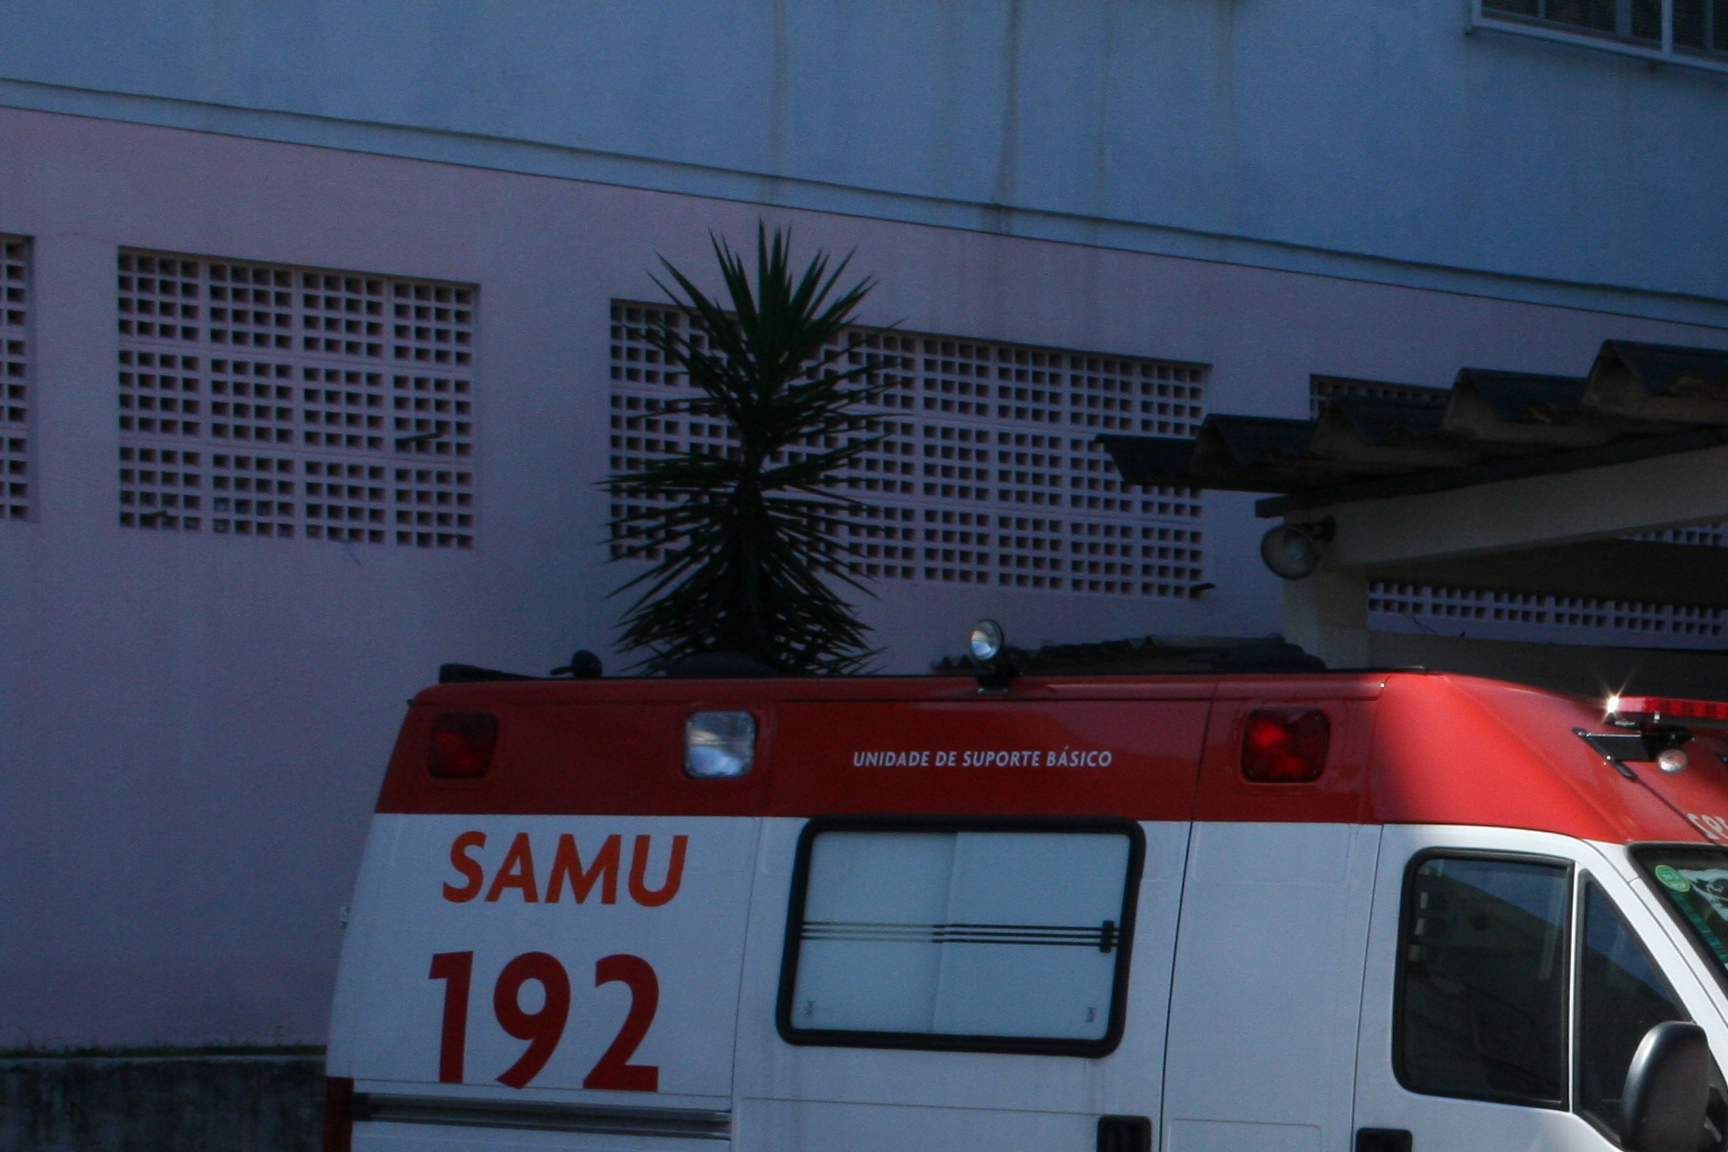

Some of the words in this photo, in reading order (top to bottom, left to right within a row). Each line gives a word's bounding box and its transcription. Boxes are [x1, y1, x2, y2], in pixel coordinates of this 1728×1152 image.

[853, 750, 930, 768] UNIDADE
[935, 750, 957, 768] DE
[962, 750, 1041, 768] SUPORTE
[1046, 745, 1113, 768] BÁSICO
[443, 831, 688, 907] SAMU
[428, 950, 661, 1093] 192
